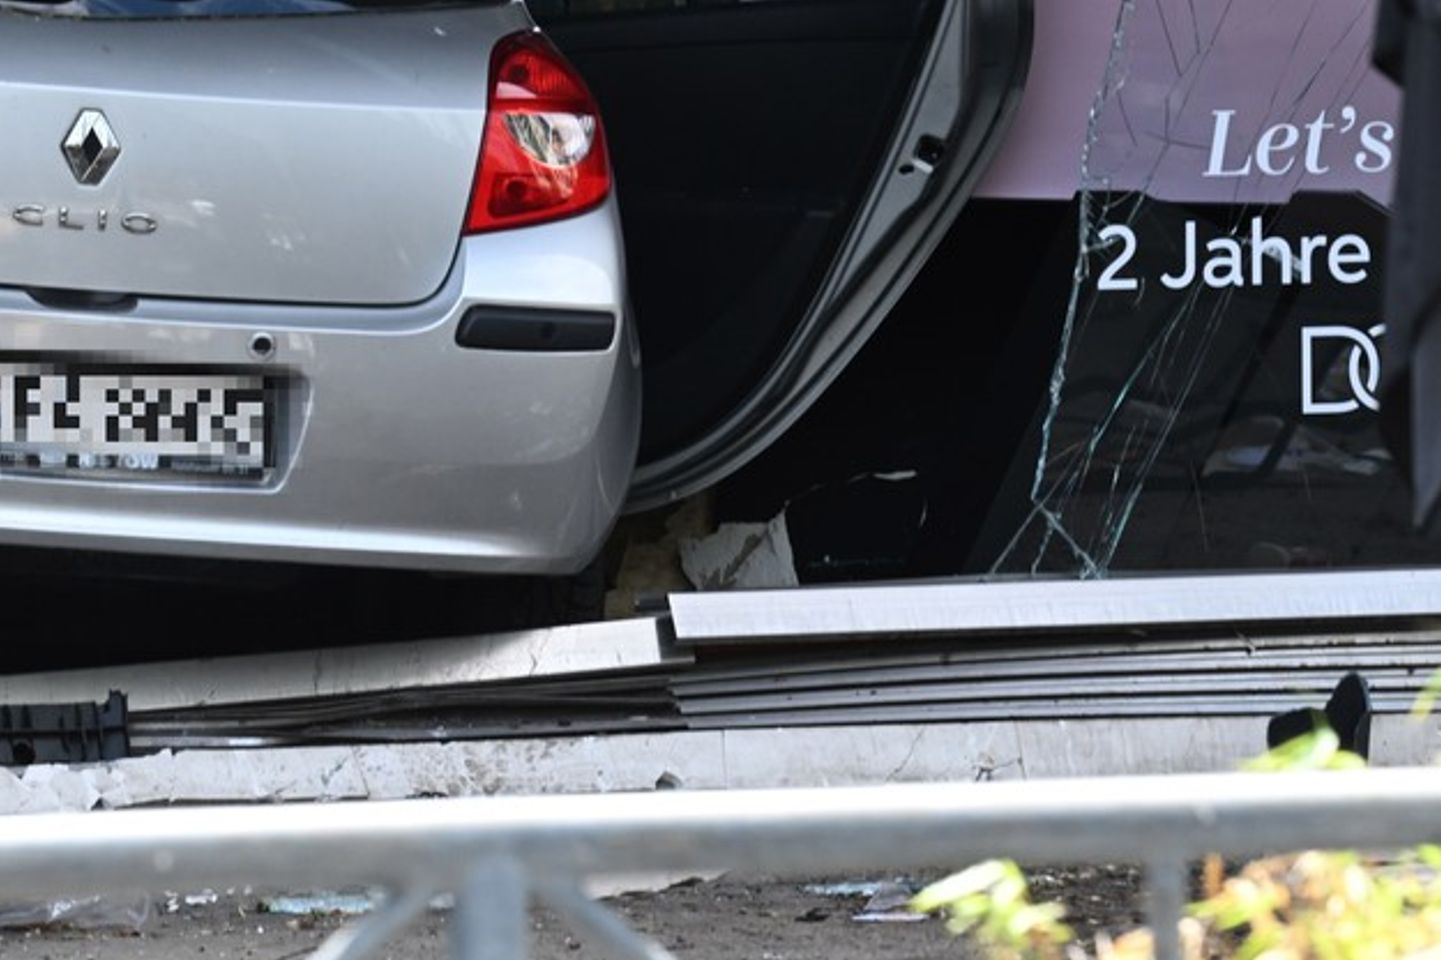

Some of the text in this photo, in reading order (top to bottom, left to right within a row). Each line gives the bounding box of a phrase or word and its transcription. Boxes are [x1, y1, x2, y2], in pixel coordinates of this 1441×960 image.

[12, 203, 158, 235] CLIO
[1097, 215, 1371, 291] 2 Jahre
